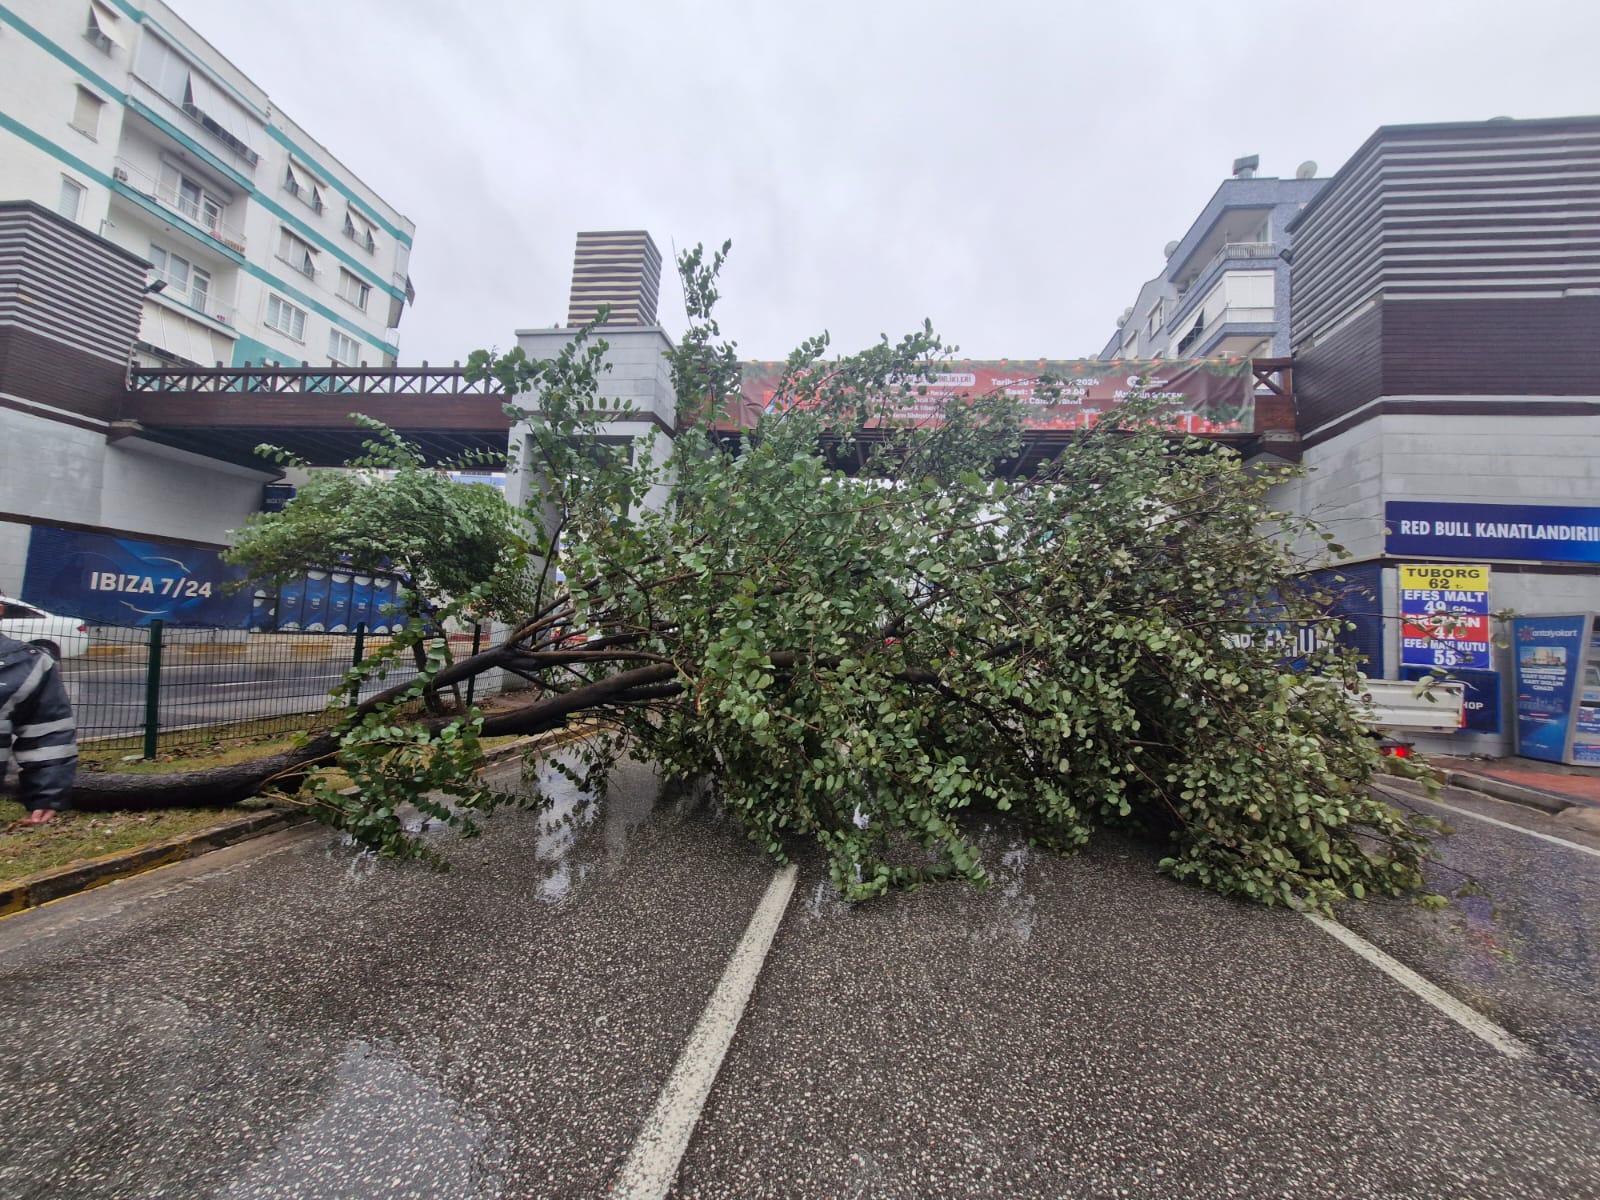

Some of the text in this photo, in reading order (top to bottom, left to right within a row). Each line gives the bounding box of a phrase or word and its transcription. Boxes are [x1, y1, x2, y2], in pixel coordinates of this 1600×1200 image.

[1401, 519, 1600, 542] RED BULL KANATLANDIRII
[1406, 568, 1480, 578] TUBORG
[90, 571, 212, 598] IBIZA 7/24
[1428, 578, 1450, 589] 62
[1404, 590, 1485, 602] EFES MALT
[1404, 638, 1428, 649] EFES
[1457, 641, 1486, 652] KUTU
[1433, 650, 1456, 666] 55
